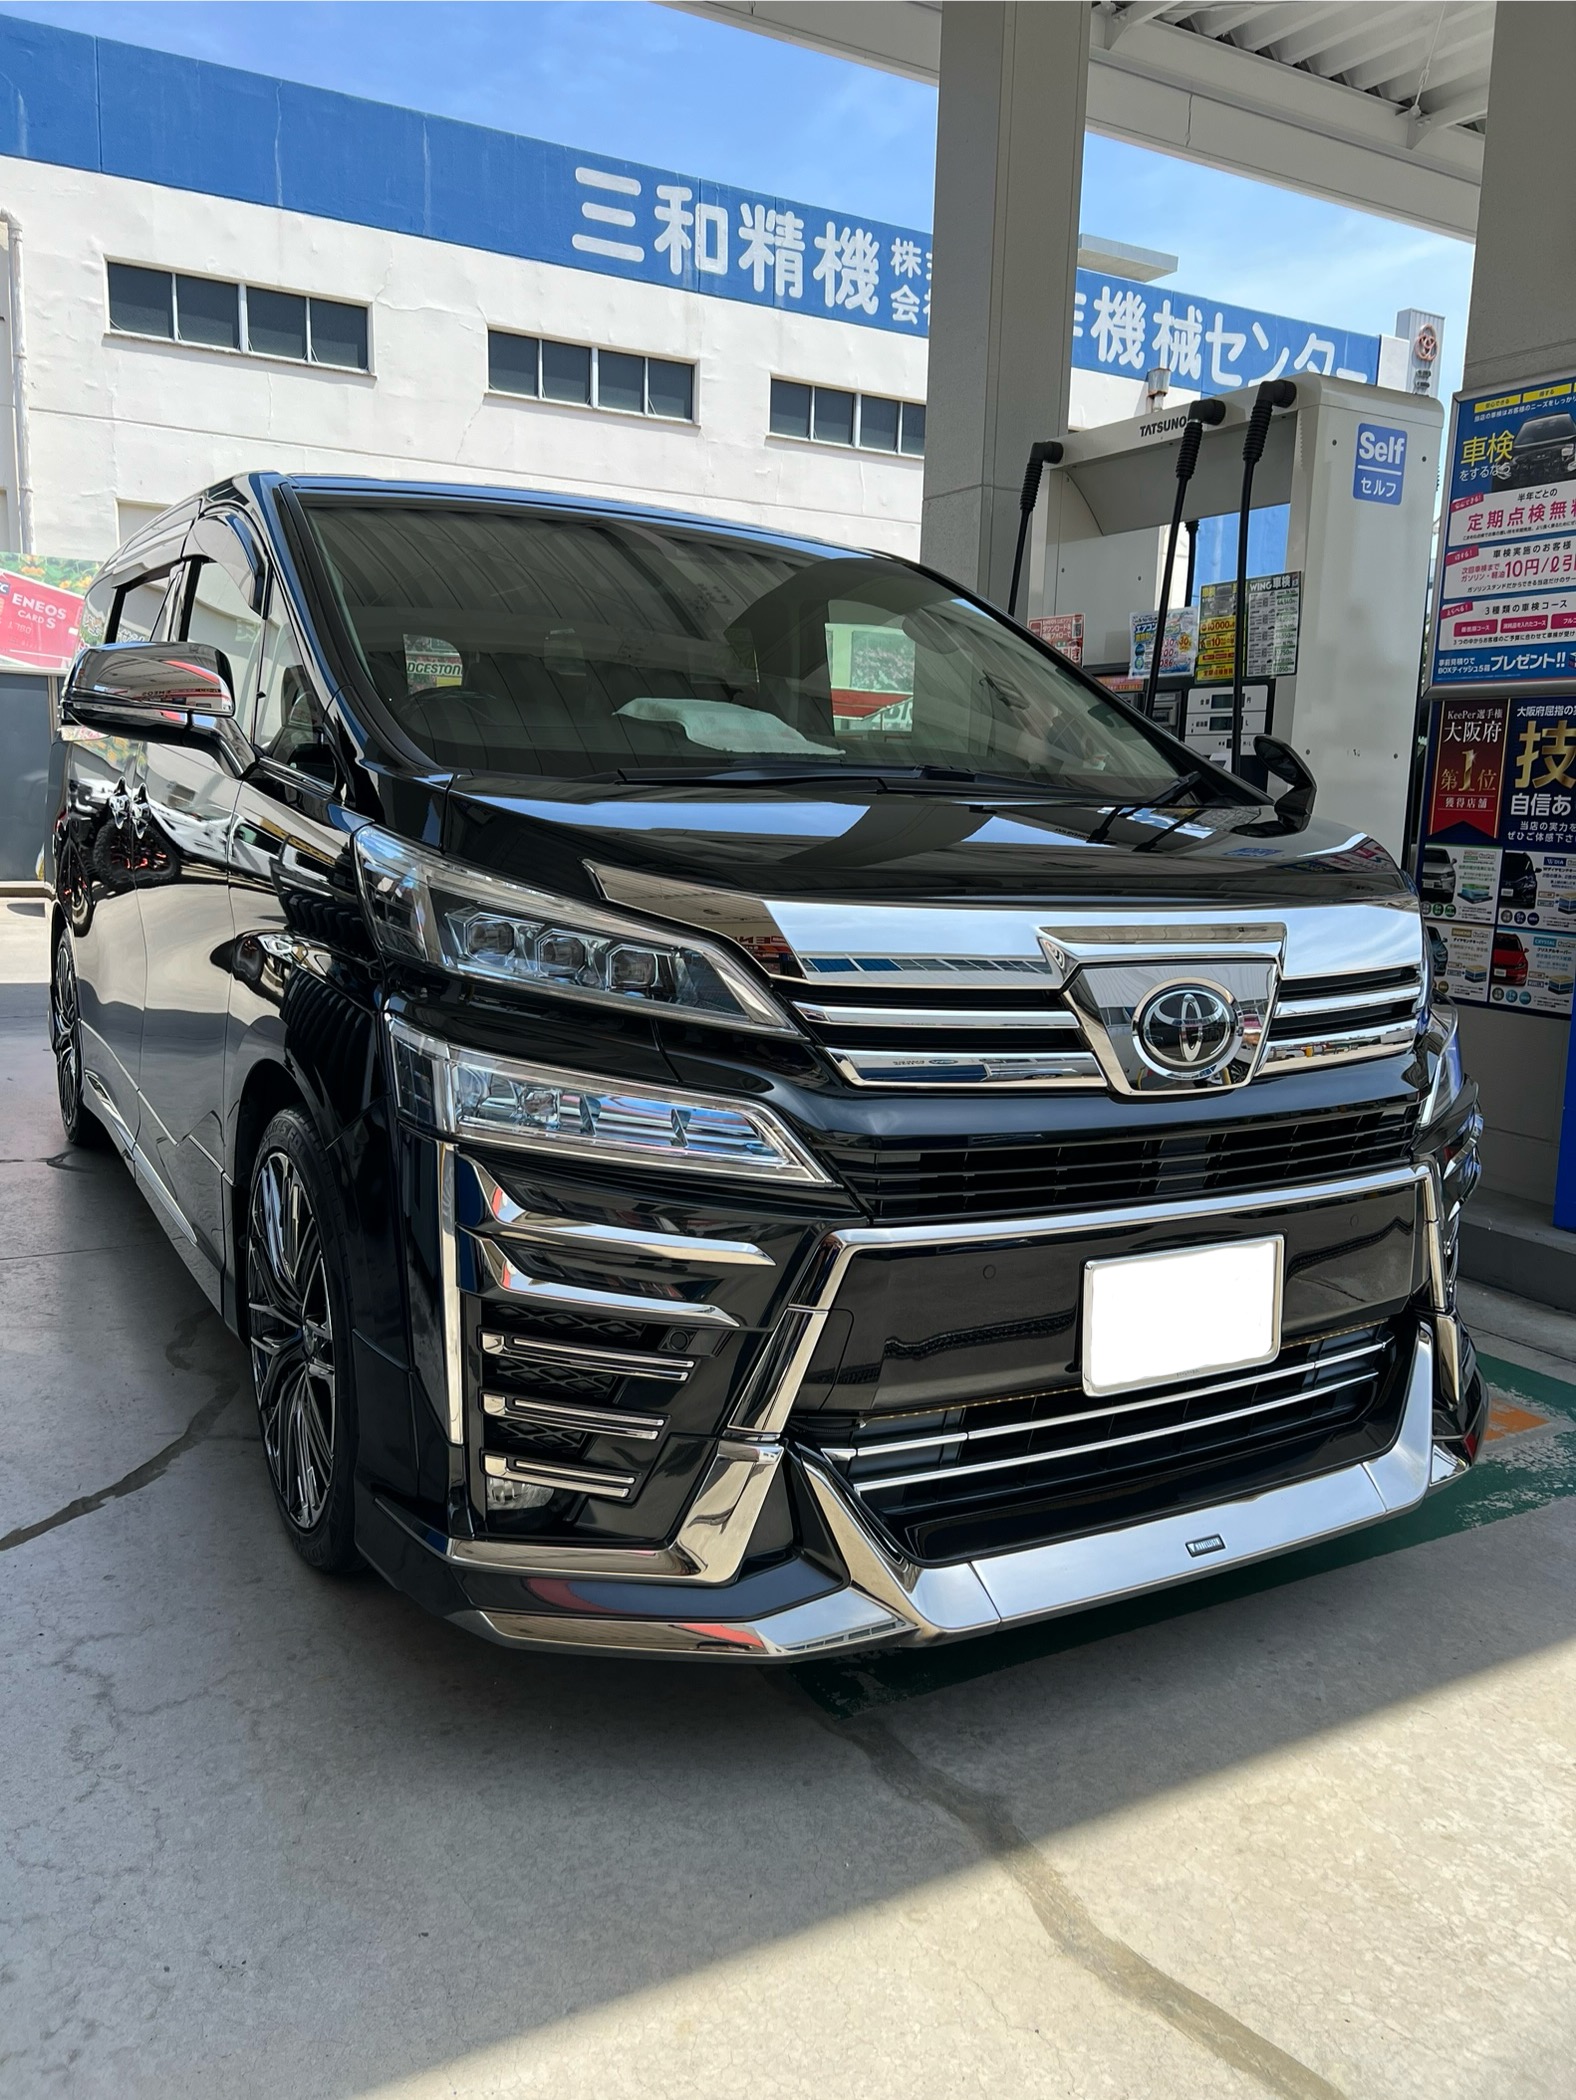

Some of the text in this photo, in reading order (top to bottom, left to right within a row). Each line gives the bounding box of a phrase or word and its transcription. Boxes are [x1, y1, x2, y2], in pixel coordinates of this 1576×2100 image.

[572, 166, 879, 315] 三和精機
[1140, 416, 1187, 437] TATSUNO
[1359, 431, 1406, 465] Self
[1461, 430, 1515, 467] 車検
[1460, 462, 1511, 481] をするなら
[1361, 477, 1397, 497] セルフ
[1518, 488, 1558, 502] 半年ごとの
[1493, 540, 1572, 558] 車検実施のお客様
[12, 593, 67, 620] ENEOS
[1485, 600, 1567, 616] 3種類の車検コース
[18, 610, 45, 624] CARD
[46, 617, 56, 629] S
[1443, 720, 1502, 743] 大阪府
[1515, 720, 1576, 789] 技
[1445, 797, 1488, 809] 獲得店舗
[1510, 793, 1576, 816] 自信あ
[1508, 832, 1576, 844] ぜひご体感下さ
